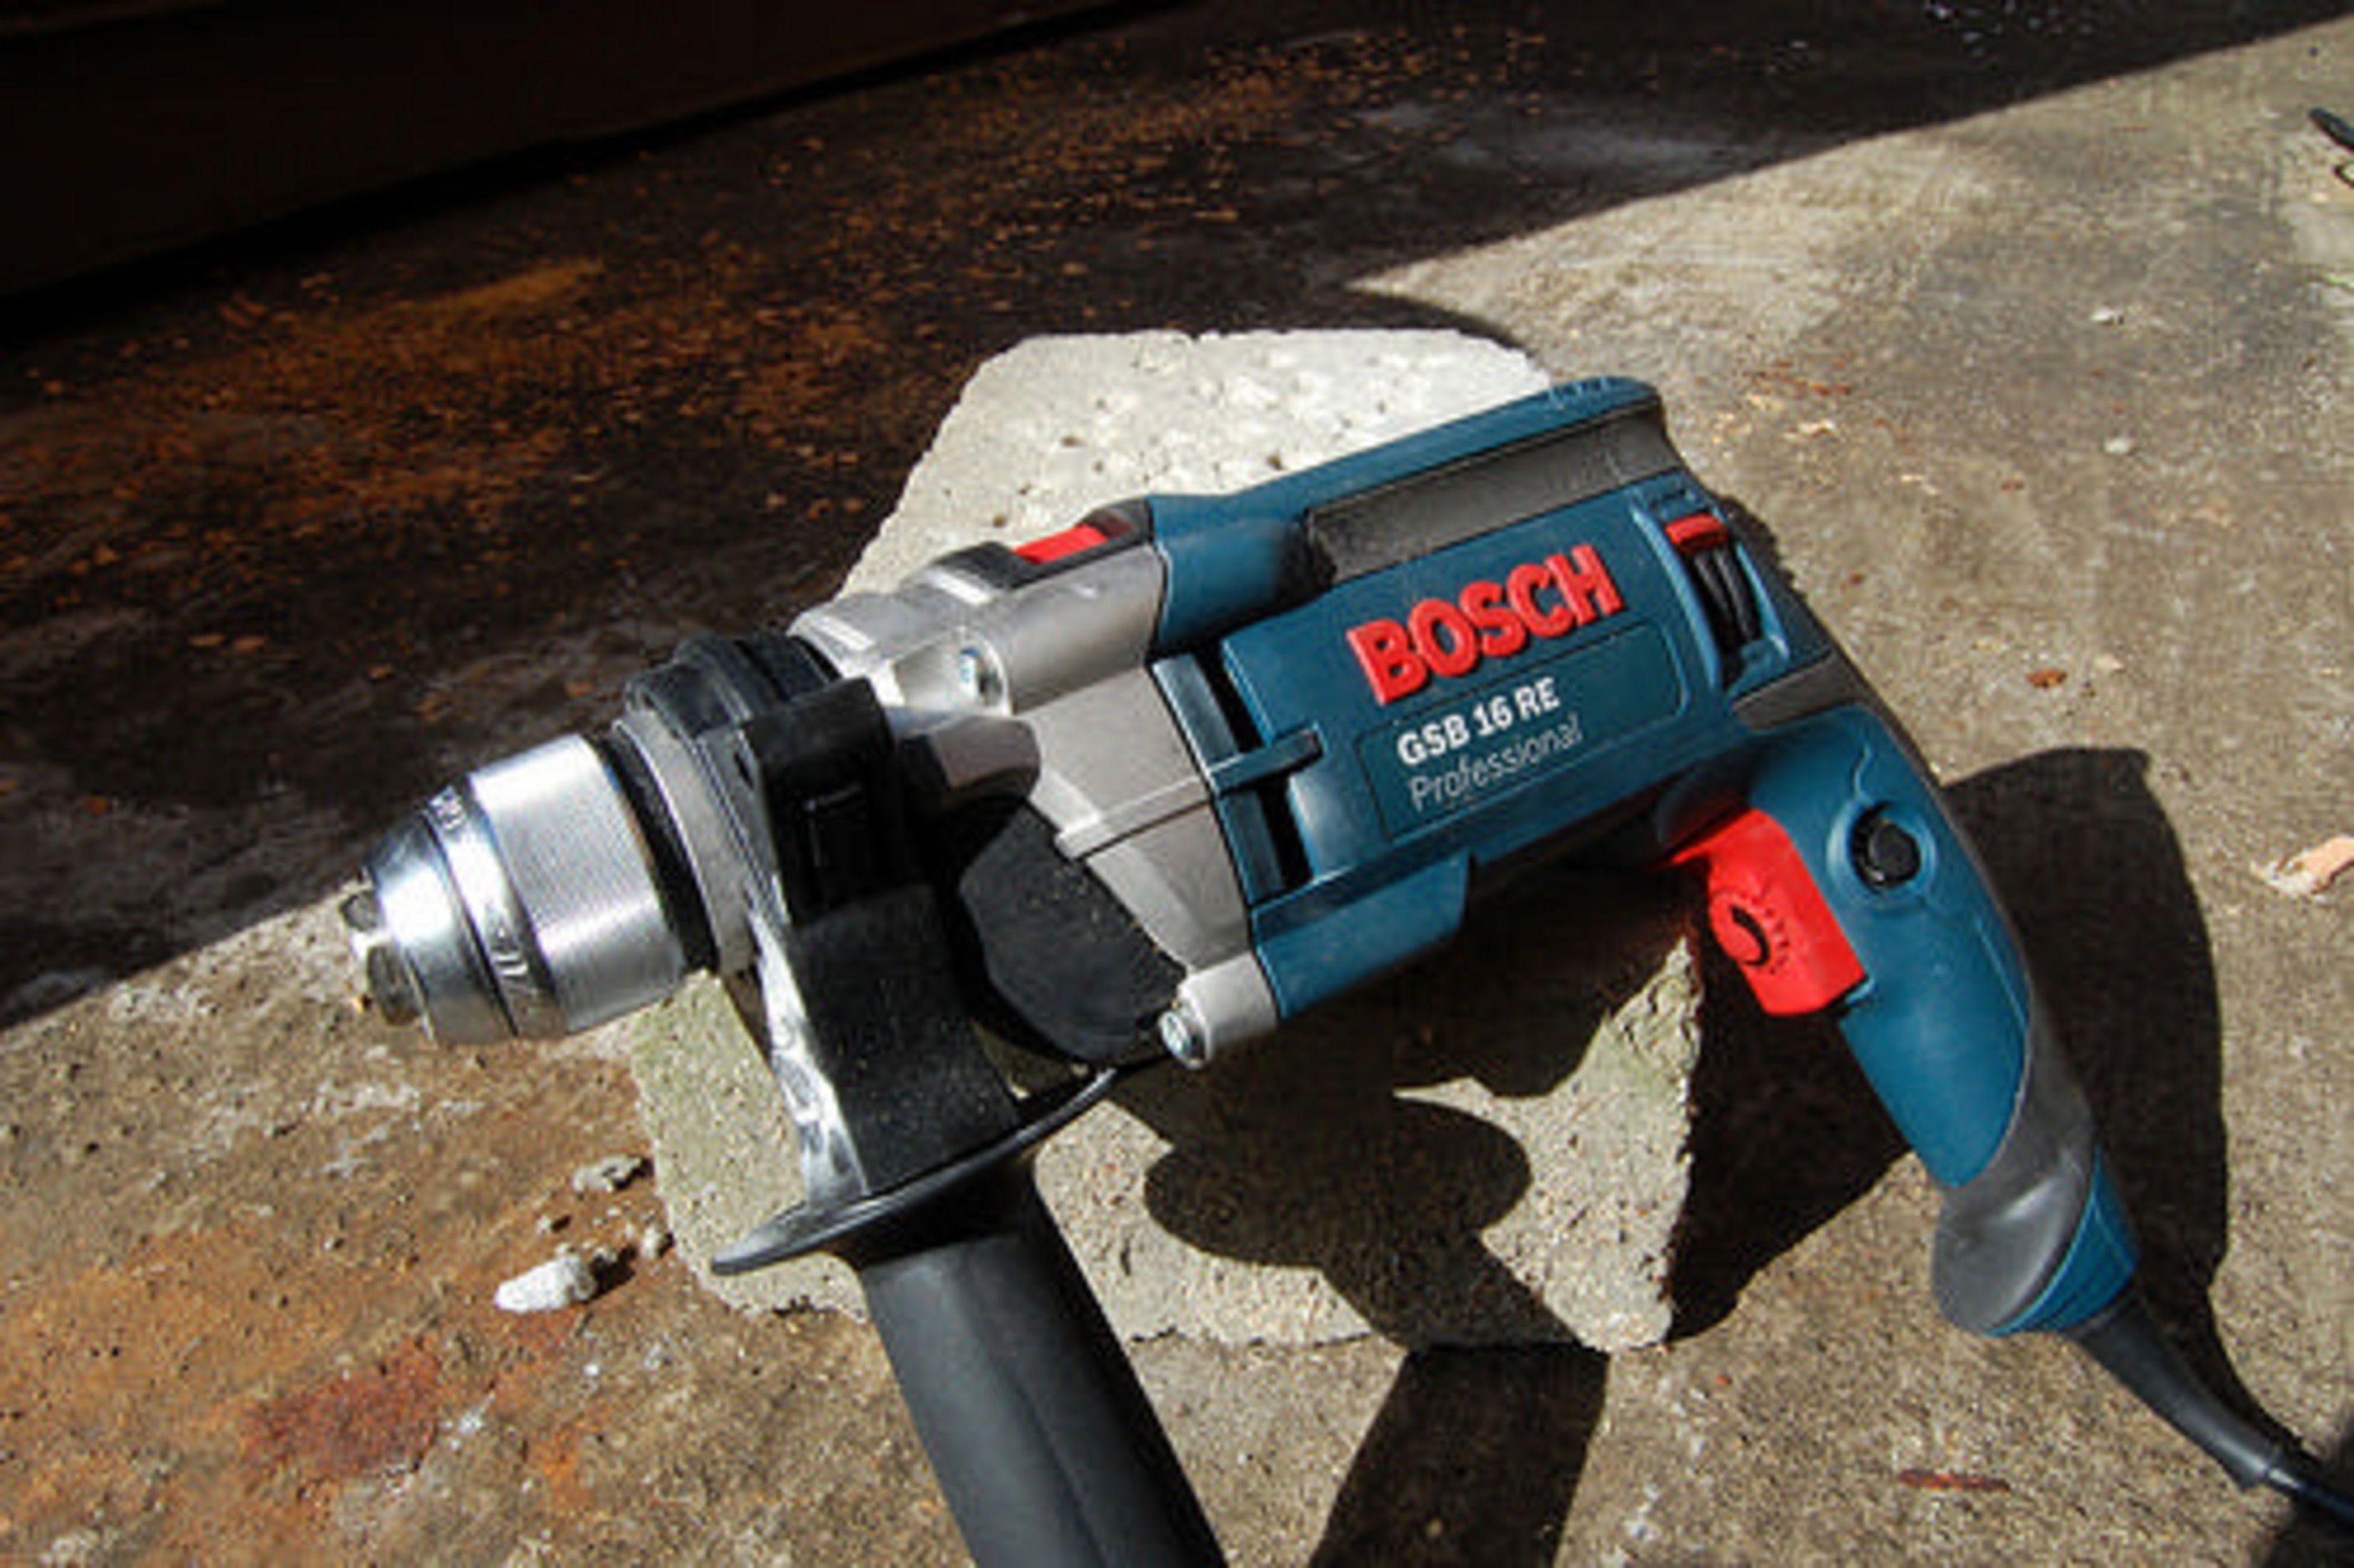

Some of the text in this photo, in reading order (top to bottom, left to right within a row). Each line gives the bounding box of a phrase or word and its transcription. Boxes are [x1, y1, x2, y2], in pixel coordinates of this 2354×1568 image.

[1346, 545, 1626, 705] BOSCH
[1397, 677, 1561, 765] GSB 16 RE
[1409, 715, 1584, 811] Professional
